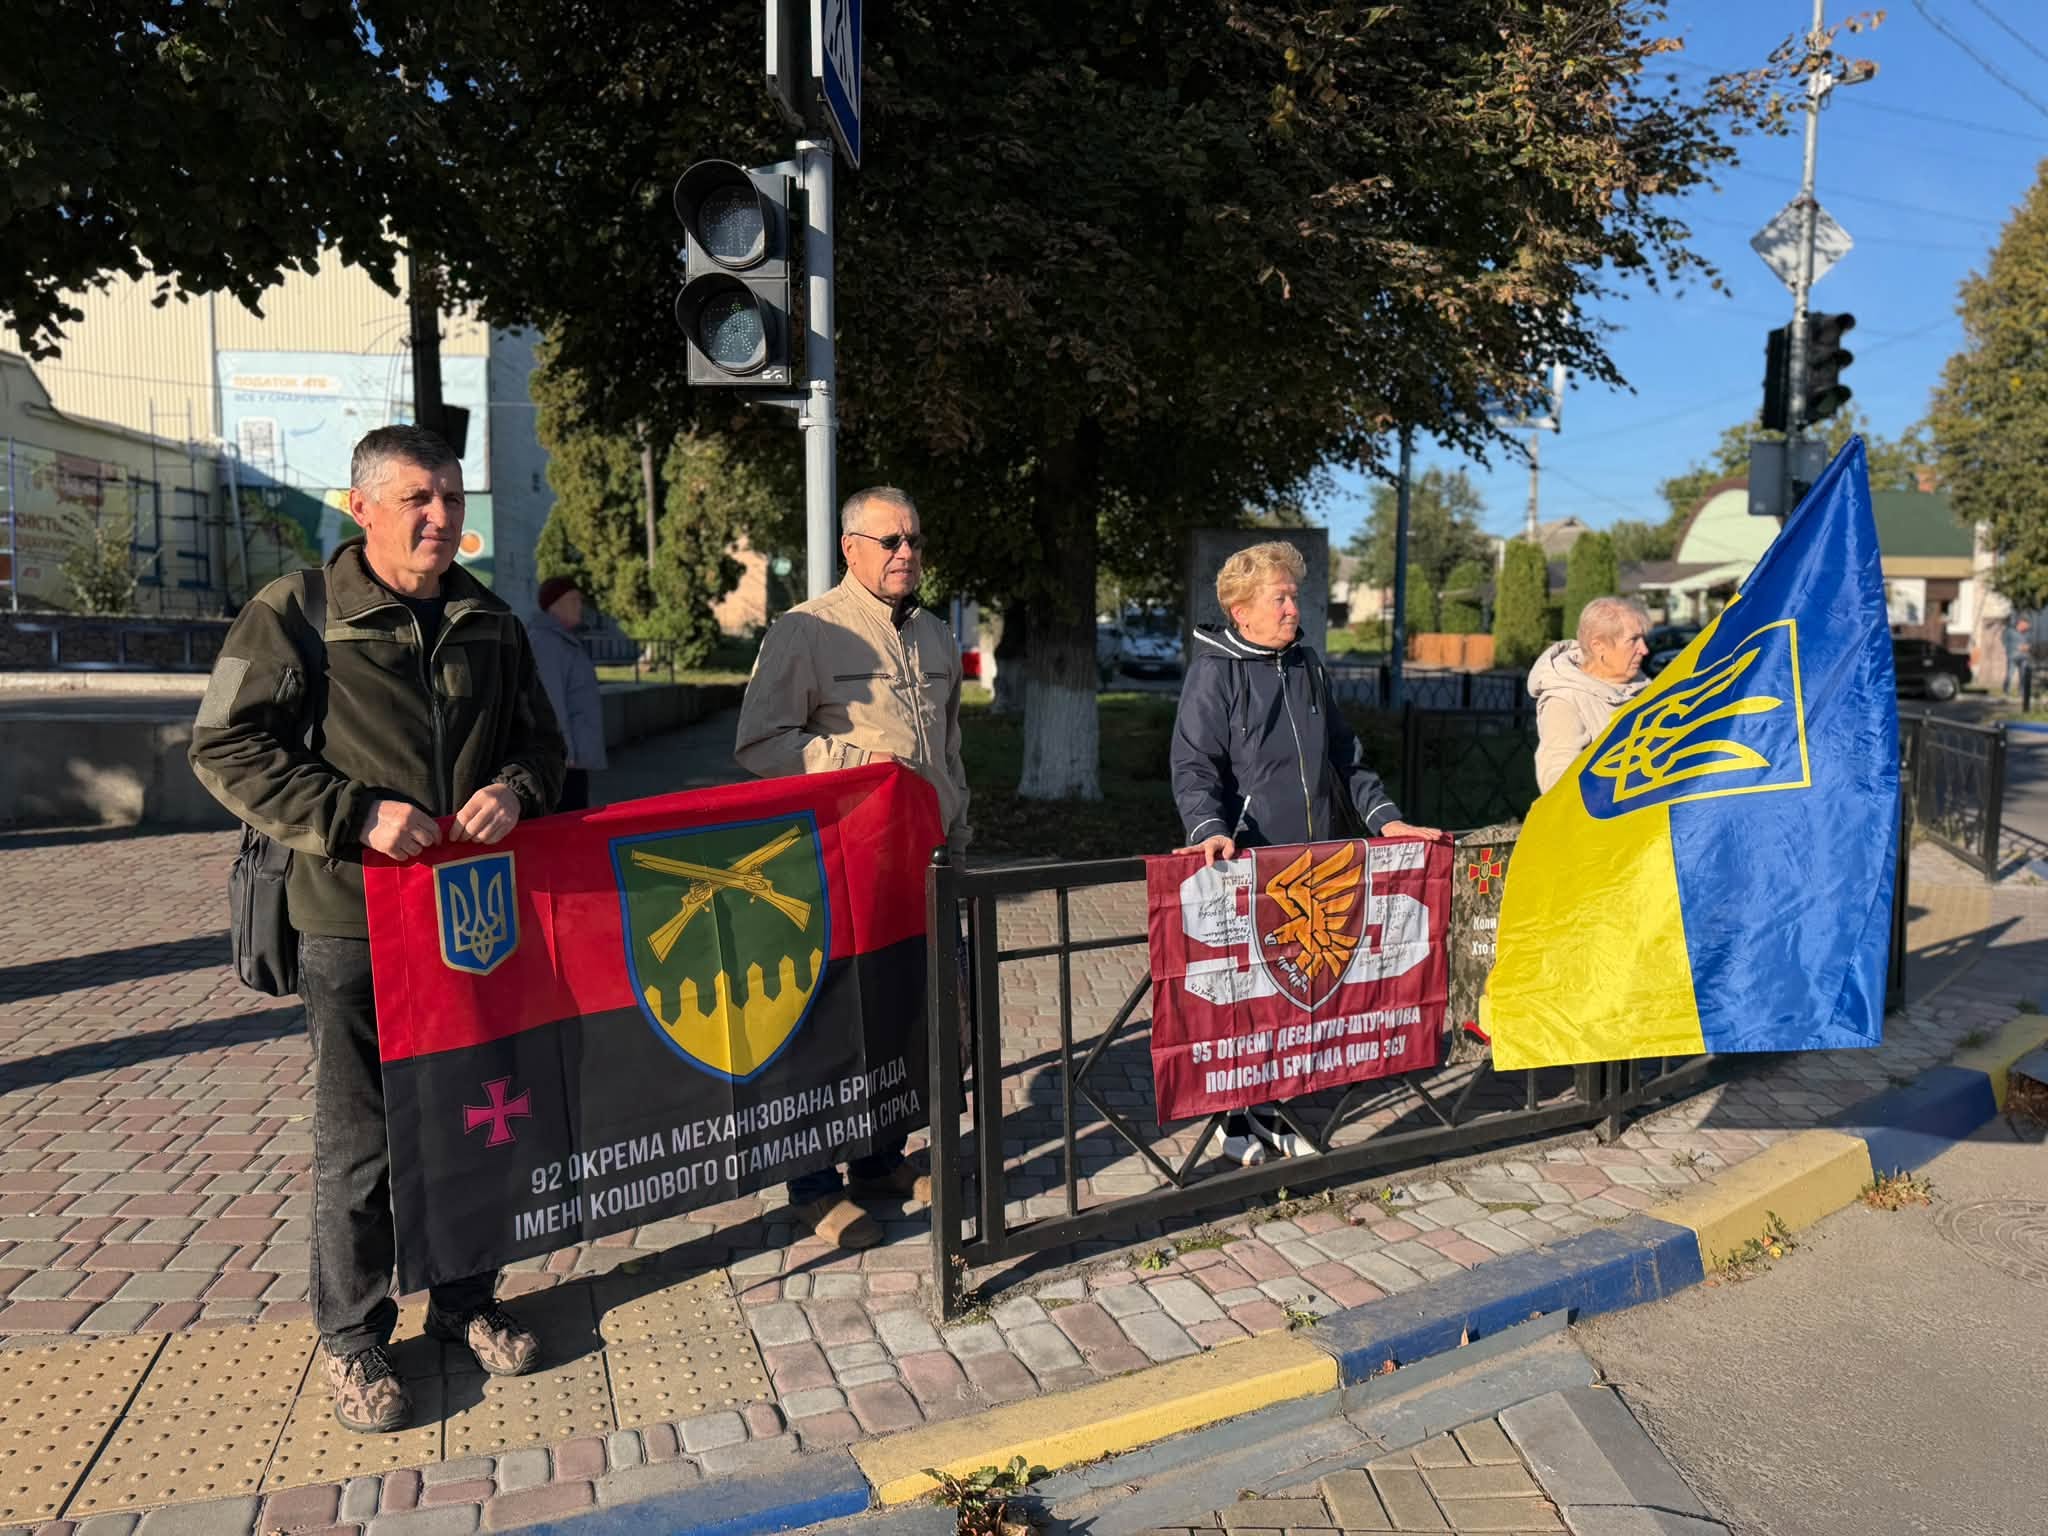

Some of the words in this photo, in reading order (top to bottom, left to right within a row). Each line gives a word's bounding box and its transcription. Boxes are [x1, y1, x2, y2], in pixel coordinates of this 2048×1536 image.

[1471, 940, 1489, 956] Хто
[1192, 1041, 1212, 1064] 95
[1217, 1030, 1273, 1059] ОКРЕМА
[1277, 1006, 1421, 1051] ДЕСАНТНО-ШТУРМОВА
[1206, 1059, 1279, 1093] ПОЛІСЬКА
[1283, 1046, 1343, 1078] БРИГАДА
[1346, 1041, 1379, 1067] ДШВ
[1383, 1035, 1407, 1058] ЗСУ
[531, 1162, 562, 1194] 92
[568, 1133, 665, 1182] ОКРЕМА
[672, 1084, 835, 1155] МЕХАНІЗОВАНА
[839, 1056, 907, 1104] БРИГАДА
[515, 1196, 582, 1240] ІМЕНІ
[590, 1159, 718, 1220] КОШОВОГО
[725, 1127, 821, 1180] ОТАМАНА
[826, 1109, 878, 1148] ІВАНА
[880, 1089, 920, 1127] СІРКА
